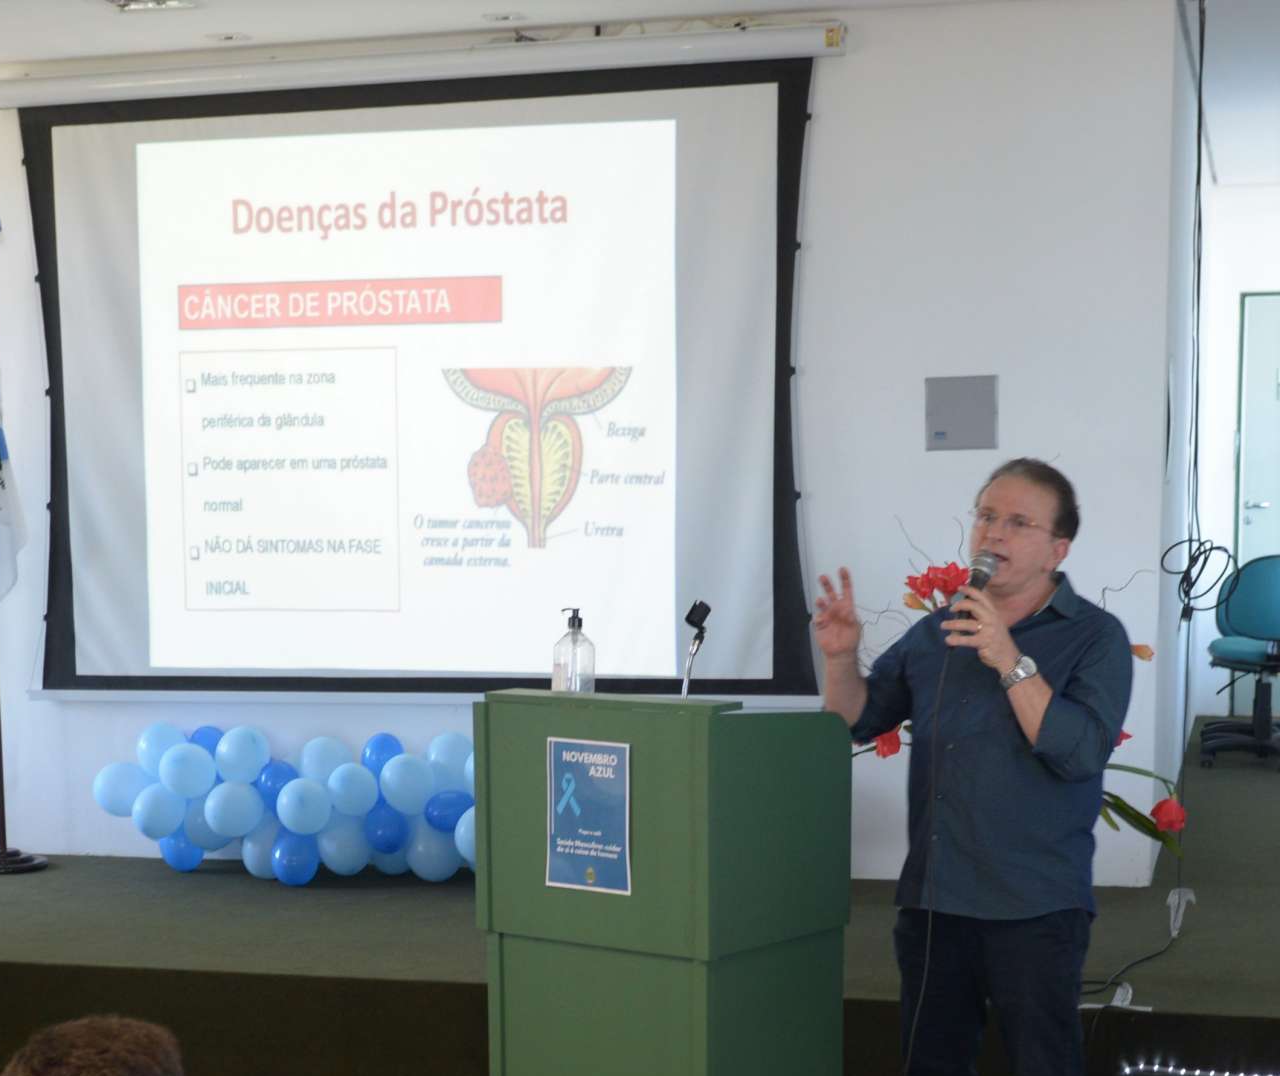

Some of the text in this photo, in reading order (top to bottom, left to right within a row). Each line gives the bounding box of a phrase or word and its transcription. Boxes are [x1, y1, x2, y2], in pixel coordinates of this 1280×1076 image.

[231, 187, 569, 240] Doenças da Próstata
[183, 284, 451, 320] CÂNCER DE PRÓSTATA
[200, 371, 336, 388] Mais frequente na zona
[201, 413, 325, 431] periférica da glândula
[607, 421, 646, 442] Bexiga
[202, 455, 388, 474] Pode aparecer em uma próstata
[590, 469, 667, 485] Parte central
[203, 498, 243, 513] normal
[413, 514, 424, 528] O
[584, 520, 624, 537] Uretra
[204, 535, 382, 554] NÃO DÁ SINTOMAS NA FASE
[461, 535, 494, 550] partir
[497, 534, 511, 548] da
[205, 580, 249, 595] INICIAL
[562, 750, 618, 766] NOVEMBRO
[588, 766, 616, 778] AZUL
